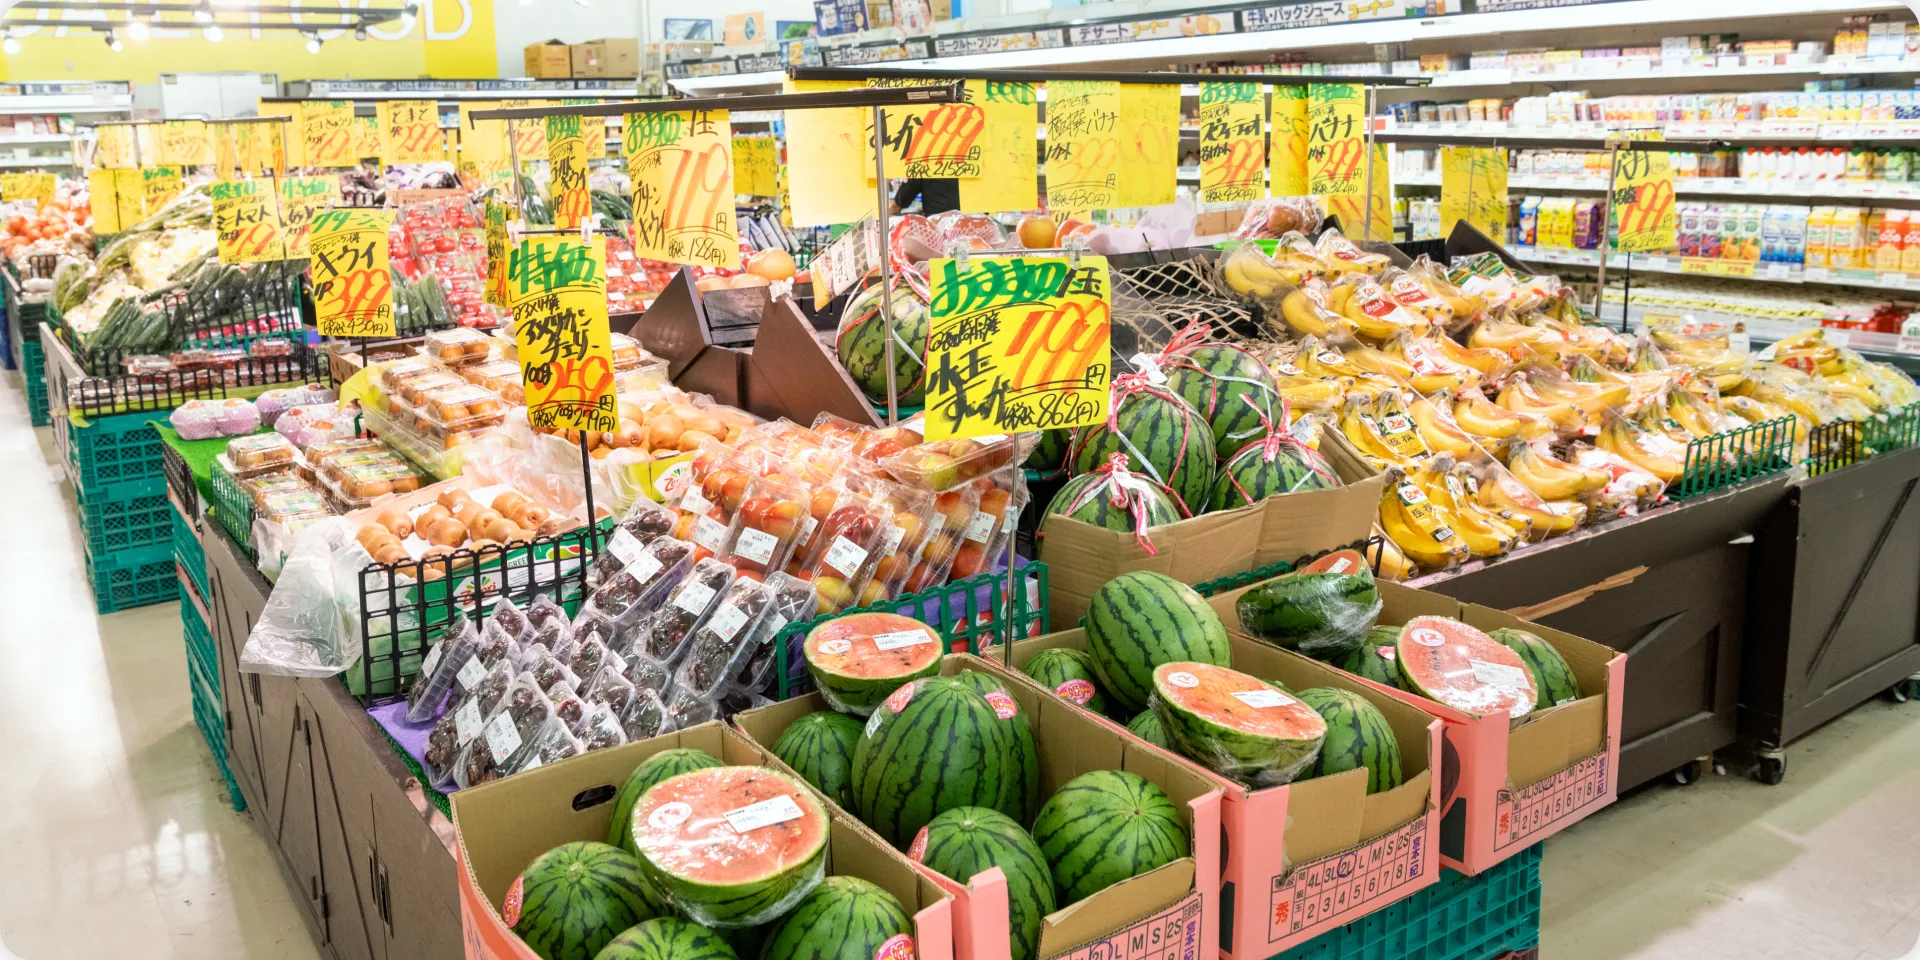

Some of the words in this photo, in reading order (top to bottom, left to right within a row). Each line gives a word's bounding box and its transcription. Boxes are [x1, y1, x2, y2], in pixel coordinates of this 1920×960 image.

[938, 37, 999, 51] ヨーグルト・プリン
[1079, 24, 1128, 40] デザート
[392, 108, 430, 123] とまと
[1309, 114, 1358, 143] バナナ
[315, 242, 377, 279] キウイ
[323, 268, 392, 322] 399
[1055, 266, 1103, 299] 1玉
[540, 328, 601, 362] チェリー
[1004, 299, 1111, 395] 799
[533, 355, 615, 412] 259
[1086, 363, 1107, 389] 円
[1388, 418, 1406, 429] Dole
[1405, 488, 1421, 500] Dole
[507, 554, 528, 568] GREE
[1522, 815, 1528, 830] 2
[1533, 809, 1539, 825] 3
[1544, 804, 1550, 817] 4
[1555, 798, 1561, 813] 5
[1566, 793, 1572, 807] 6
[1577, 787, 1582, 801] 7
[1587, 782, 1593, 797] 8
[1307, 870, 1321, 889] 4L
[1323, 865, 1337, 884] 3L
[1358, 854, 1365, 869] L
[1371, 848, 1382, 862] M
[1386, 840, 1394, 856] S
[1397, 832, 1410, 851] 2S
[1307, 903, 1315, 920] 2
[1323, 897, 1331, 913] 3
[1338, 891, 1346, 906] 4
[1353, 884, 1361, 899] 5
[1368, 877, 1376, 893] 6
[1382, 870, 1389, 886] 7
[1395, 864, 1403, 880] 8
[1275, 901, 1290, 925] 秀
[1115, 944, 1123, 959] L
[1131, 933, 1144, 953] M
[1151, 927, 1161, 945] S
[1166, 918, 1182, 940] 2S
